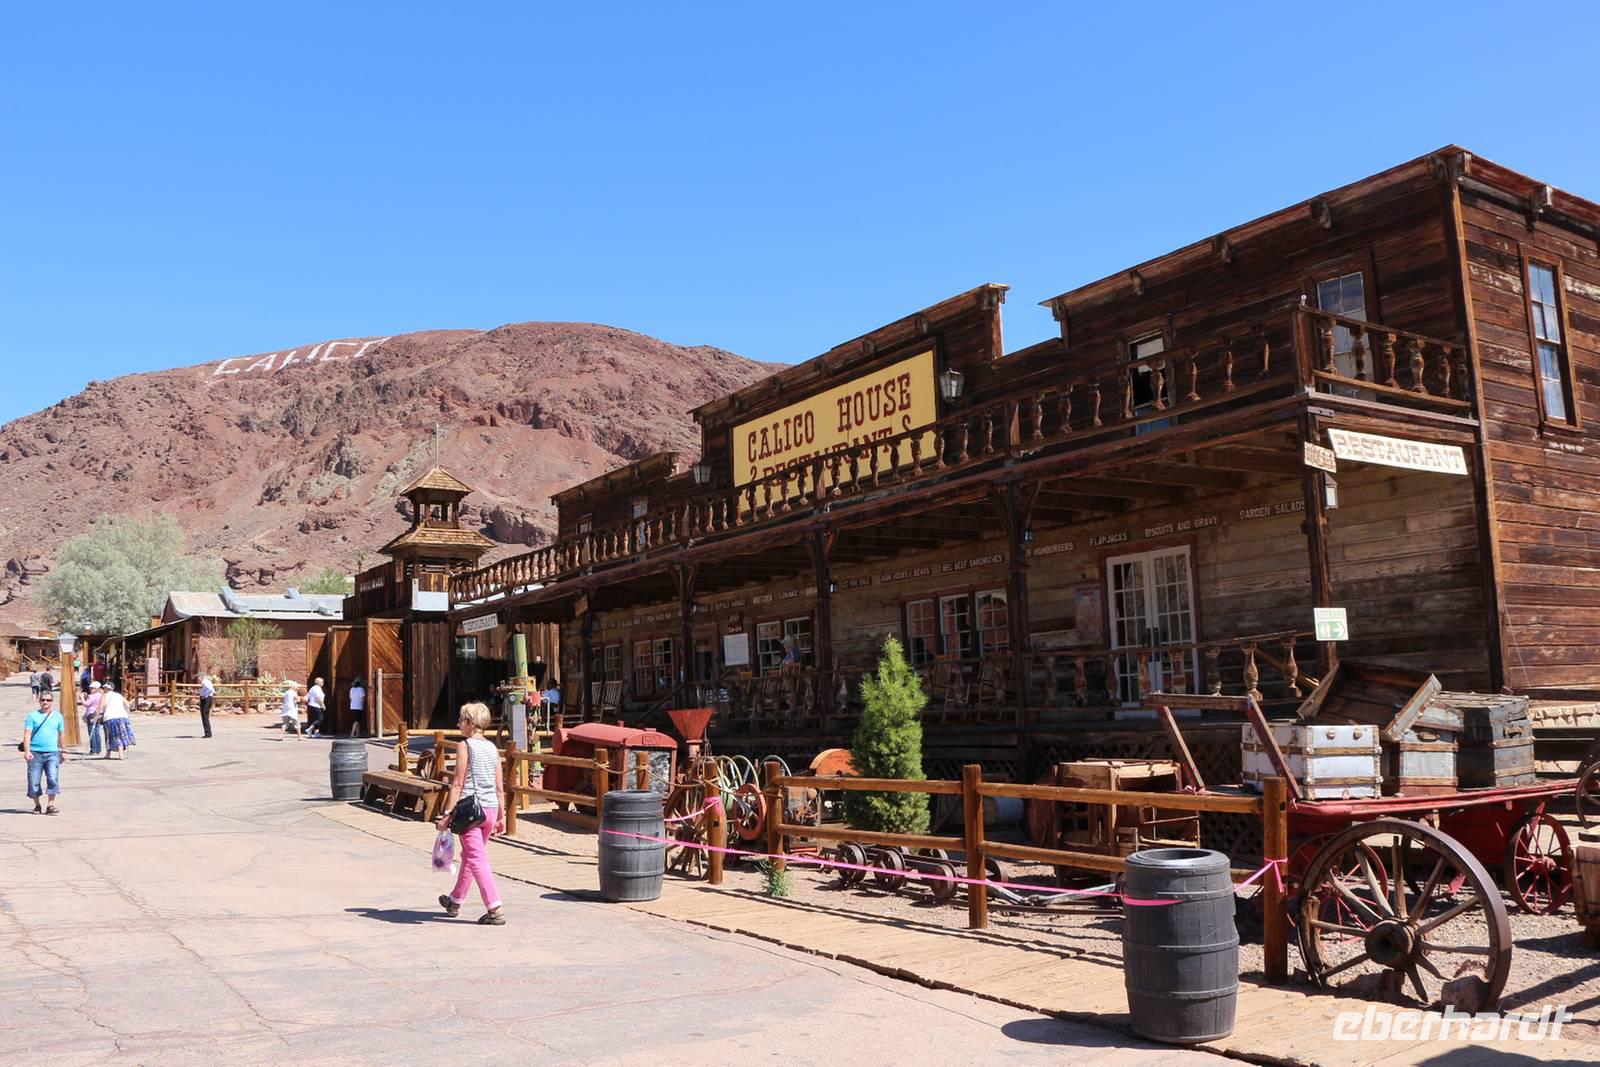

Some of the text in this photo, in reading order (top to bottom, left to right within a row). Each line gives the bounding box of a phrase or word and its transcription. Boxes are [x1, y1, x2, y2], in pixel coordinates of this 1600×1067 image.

[747, 373, 912, 464] CALICO HOUSE
[1331, 433, 1462, 469] RESTAURANT
[1239, 506, 1271, 520] GARDEN
[1144, 515, 1218, 538] BISCUITS AND GRAVY
[1089, 531, 1128, 546] FLAPJACKS
